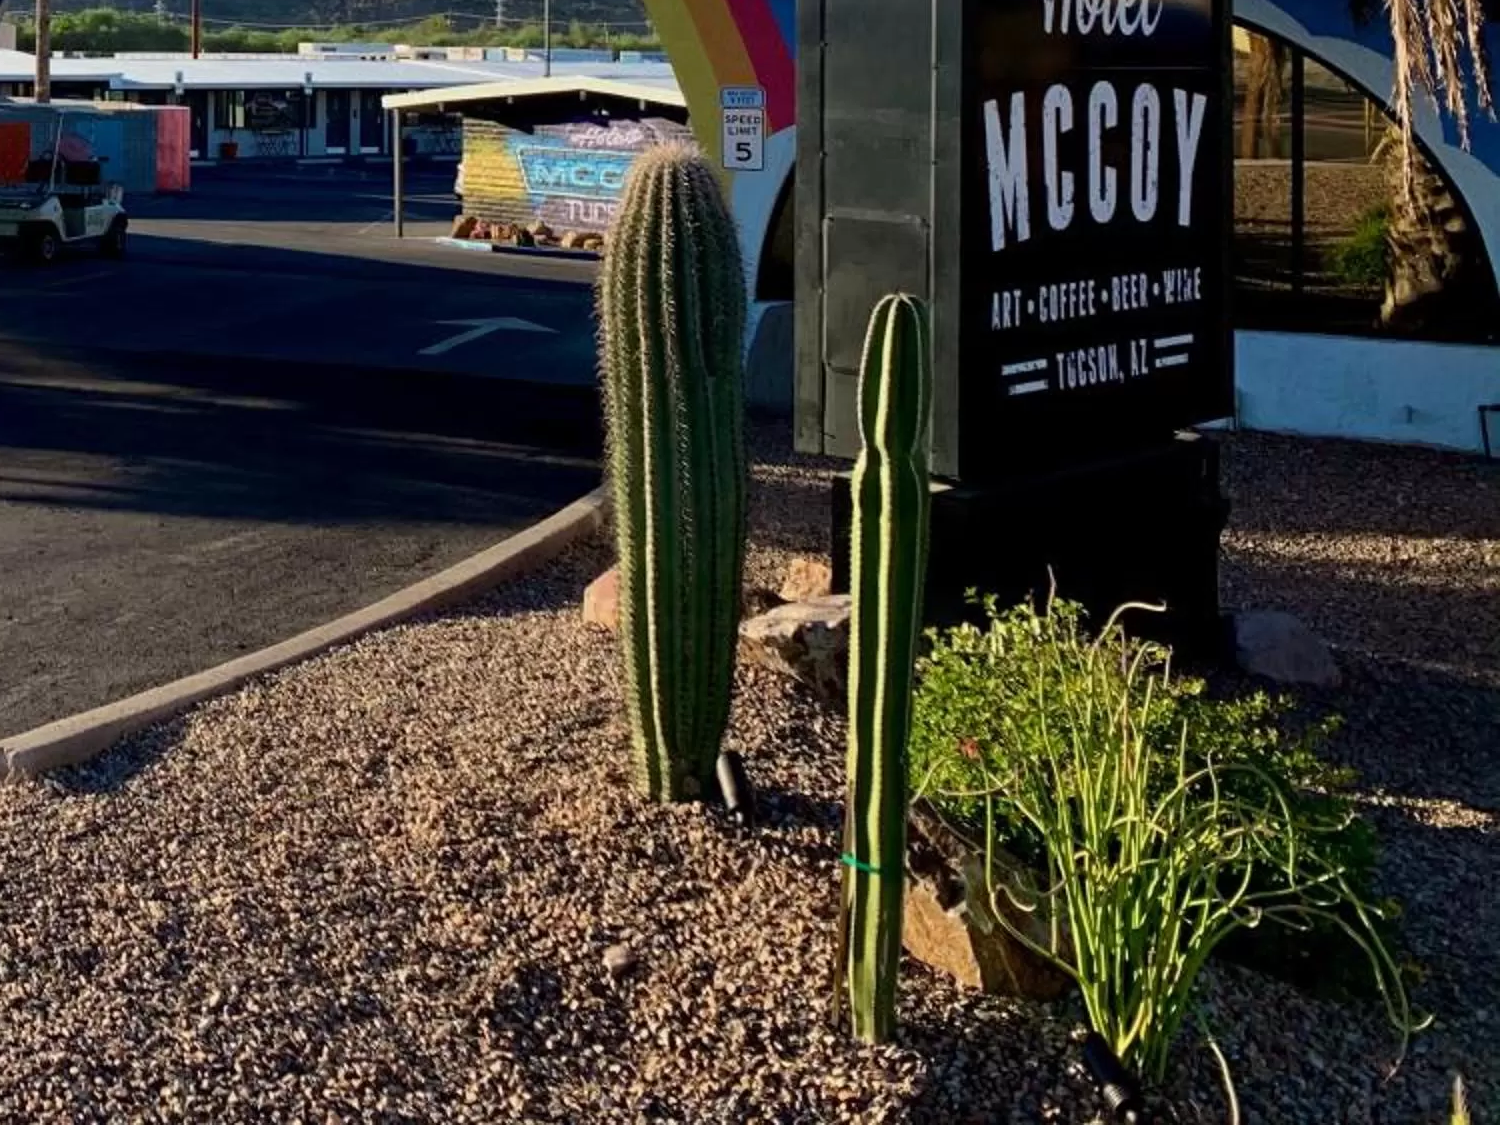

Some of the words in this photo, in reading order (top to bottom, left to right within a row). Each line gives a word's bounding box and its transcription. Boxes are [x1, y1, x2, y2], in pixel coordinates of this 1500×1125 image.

[725, 114, 761, 124] SPEED
[727, 126, 757, 136] LIMIT
[736, 142, 752, 162] 5
[531, 159, 625, 189] MCC
[983, 80, 1207, 252] MCCOY
[565, 199, 617, 223] TUCS
[992, 289, 1021, 330] ART
[1039, 280, 1096, 323] COFFEE
[1111, 273, 1148, 312] BEER
[1162, 267, 1201, 304] WINE
[1056, 343, 1125, 390] TUCSON,
[1130, 338, 1149, 377] AZ
